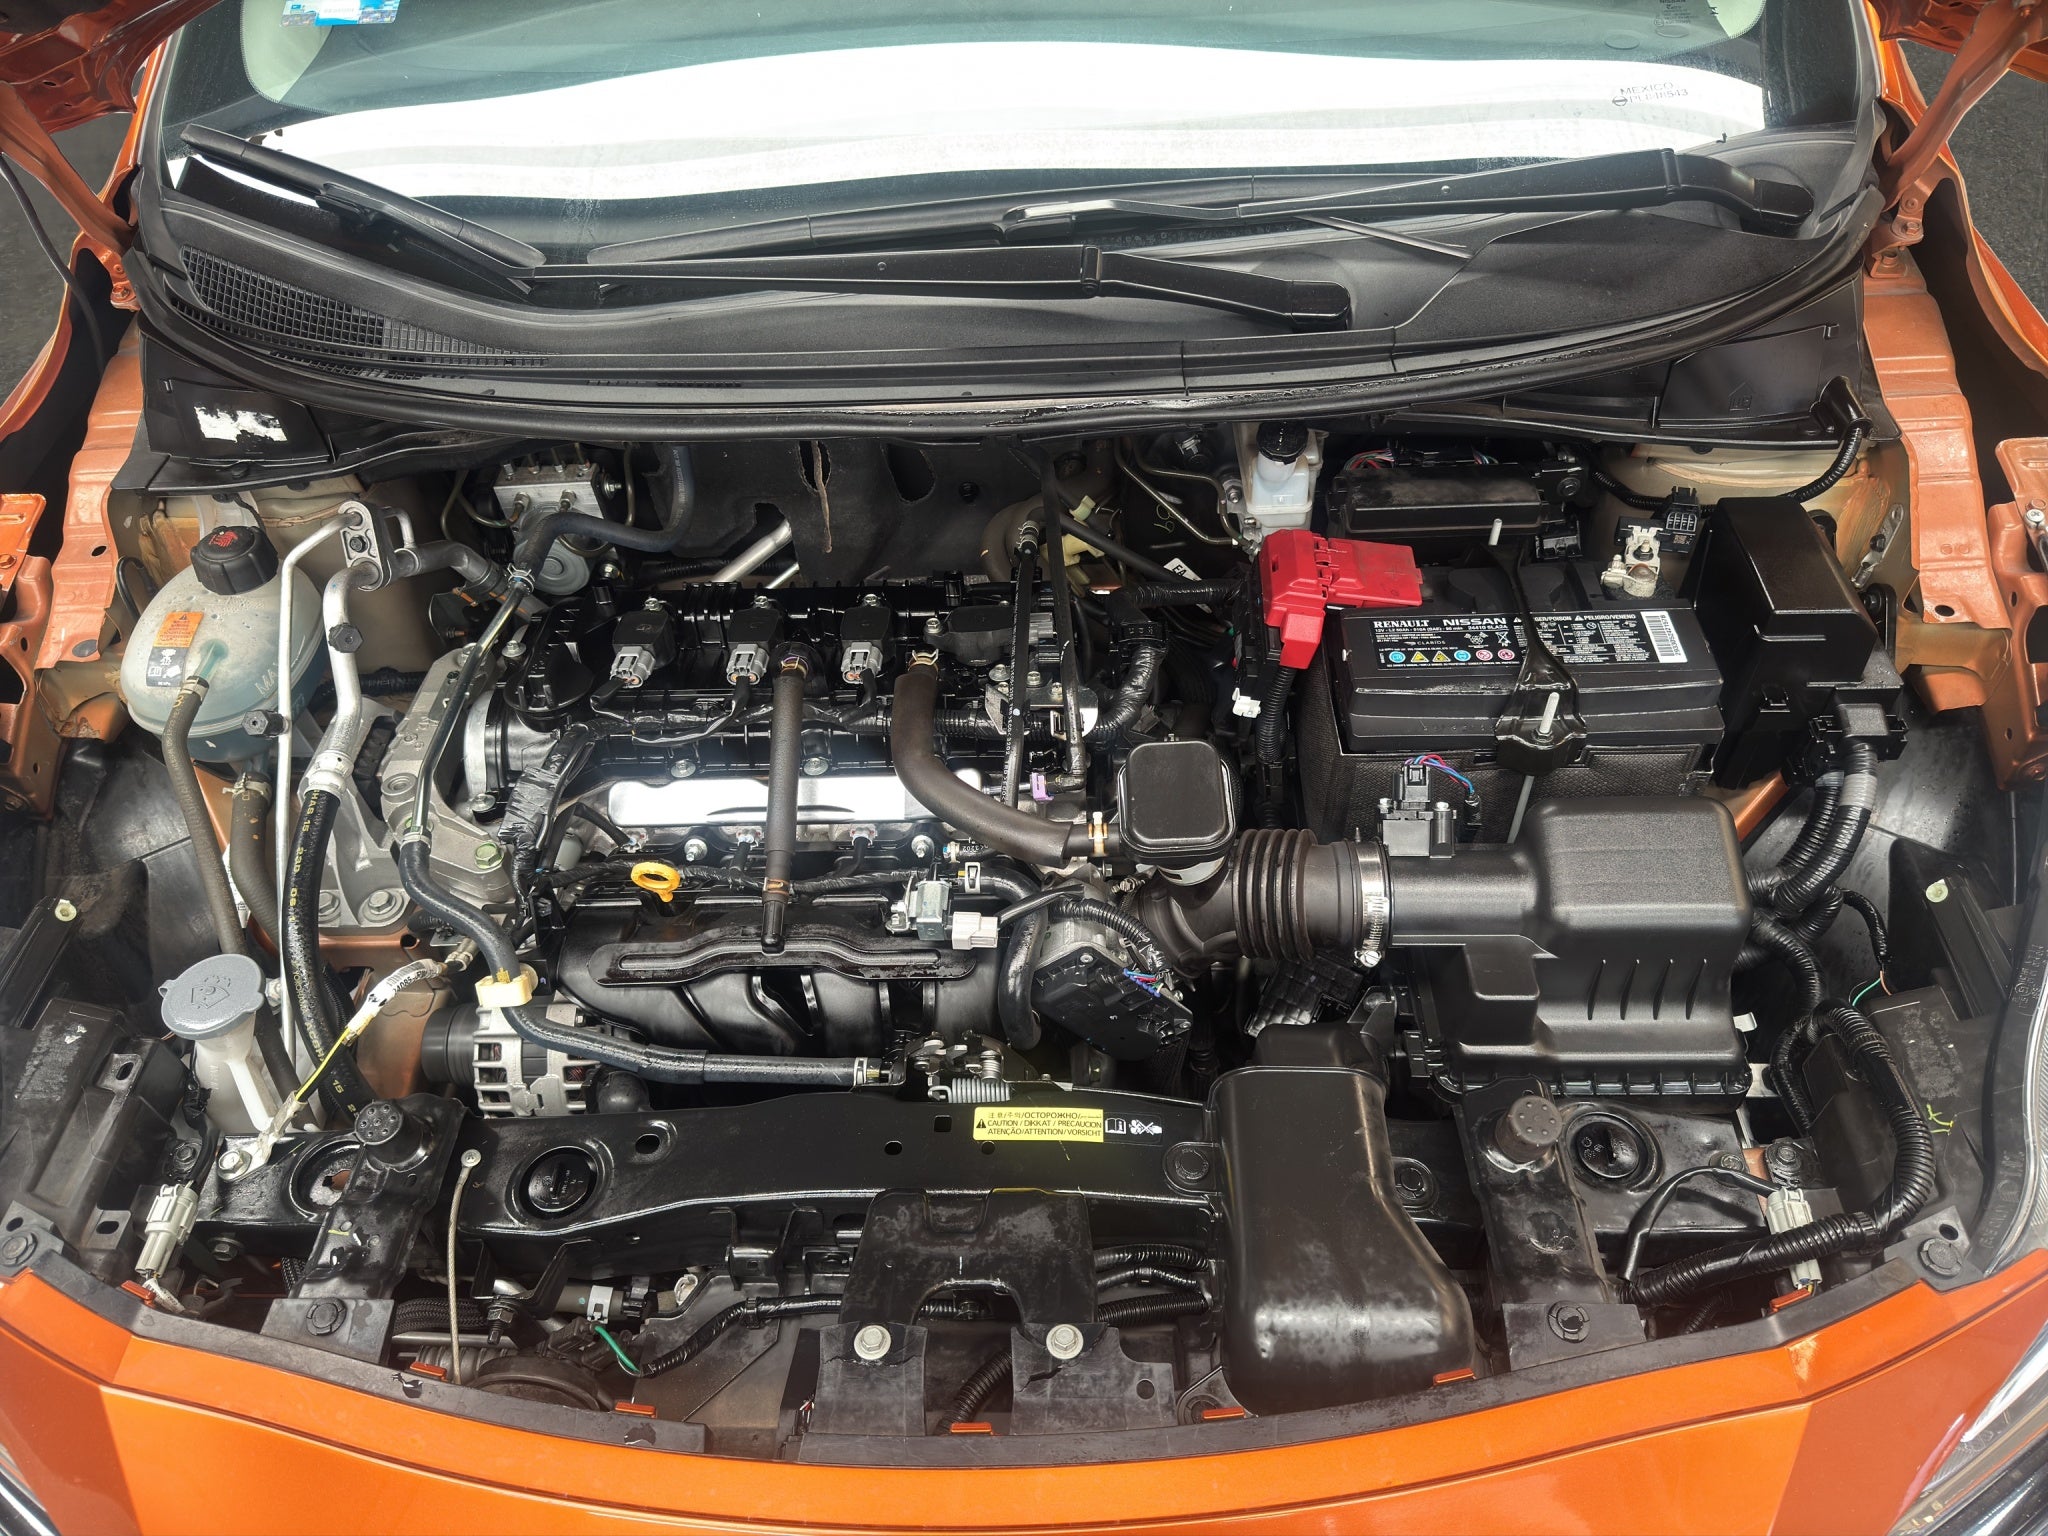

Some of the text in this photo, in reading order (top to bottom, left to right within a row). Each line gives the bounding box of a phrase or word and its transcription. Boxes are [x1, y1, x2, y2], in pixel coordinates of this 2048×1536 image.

[1620, 82, 1674, 96] MEXICO
[1373, 617, 1507, 628] RENAULT NISSAN
[302, 819, 311, 832] 15
[293, 973, 310, 1015] YOKOHAMA
[1057, 1120, 1102, 1128] PRECAUCION
